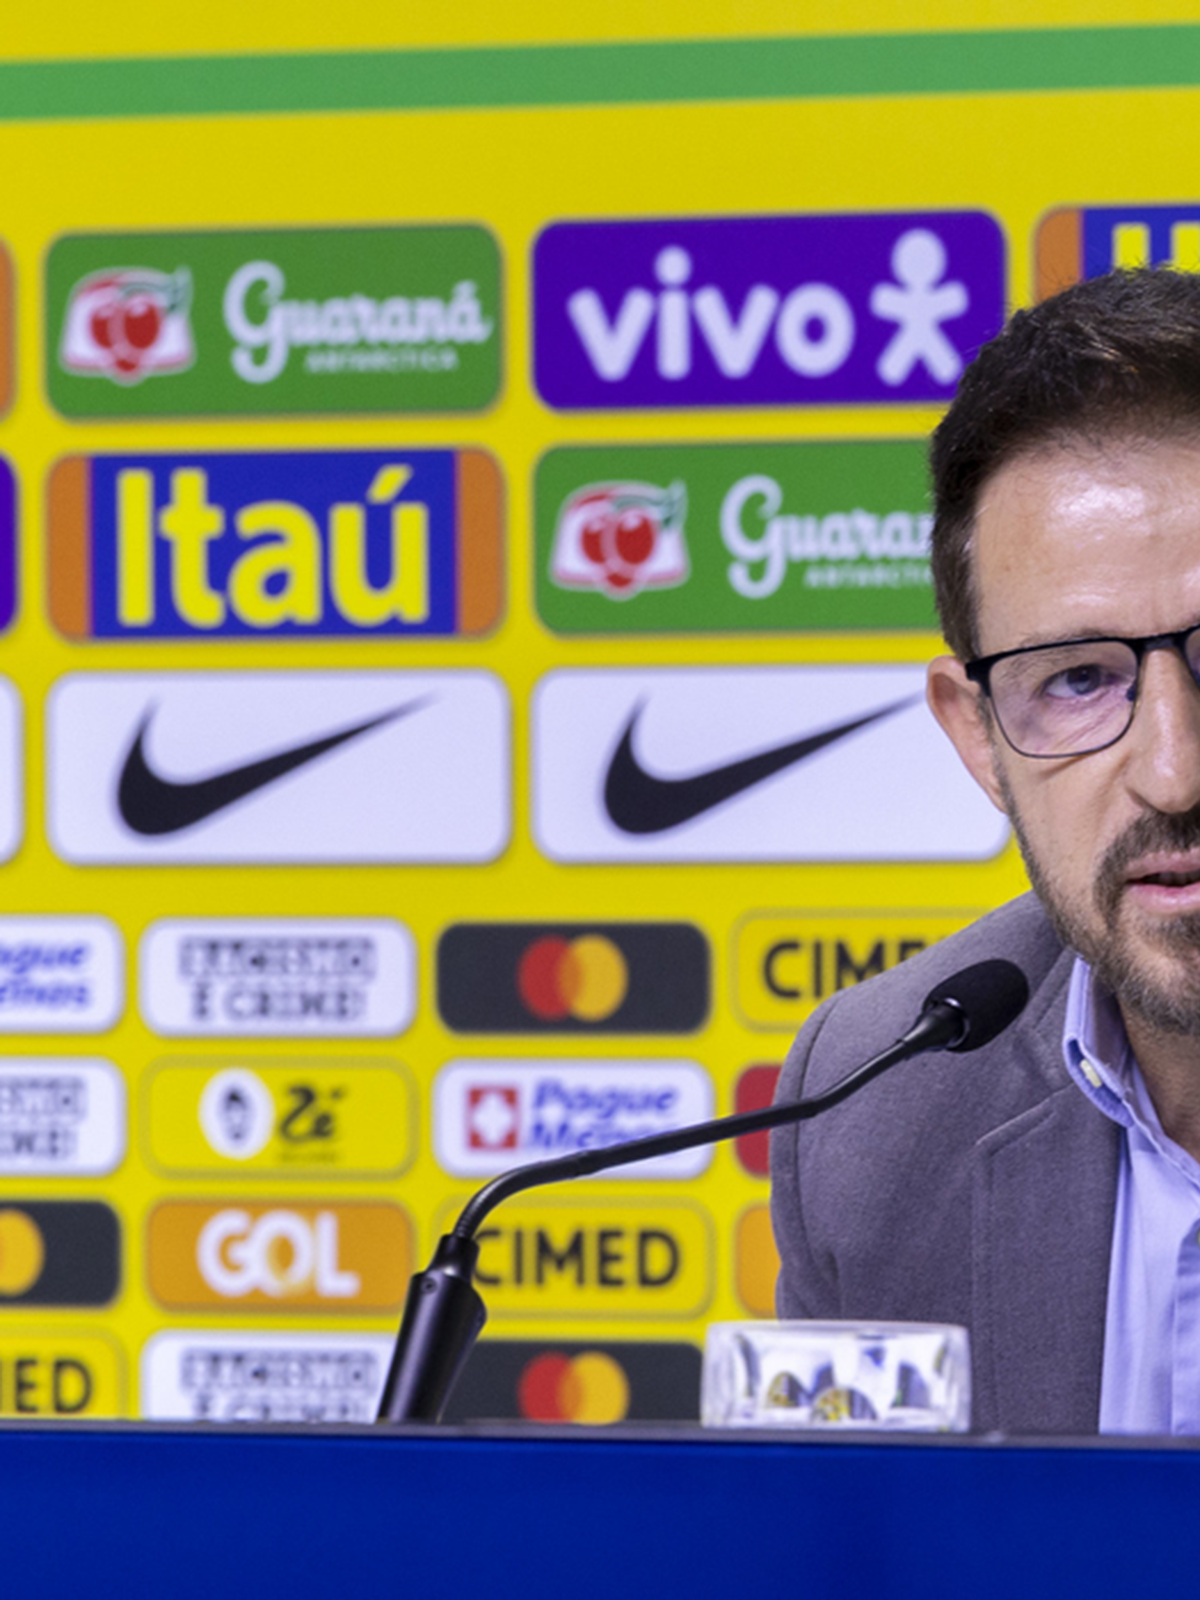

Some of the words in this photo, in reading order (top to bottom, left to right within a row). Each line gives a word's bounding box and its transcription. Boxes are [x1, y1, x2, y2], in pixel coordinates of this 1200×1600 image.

[223, 260, 493, 384] Guaraná
[568, 246, 855, 380] vivo
[116, 464, 429, 628] Itaú
[197, 1208, 361, 1297] GOL
[474, 1228, 682, 1288] CIMED
